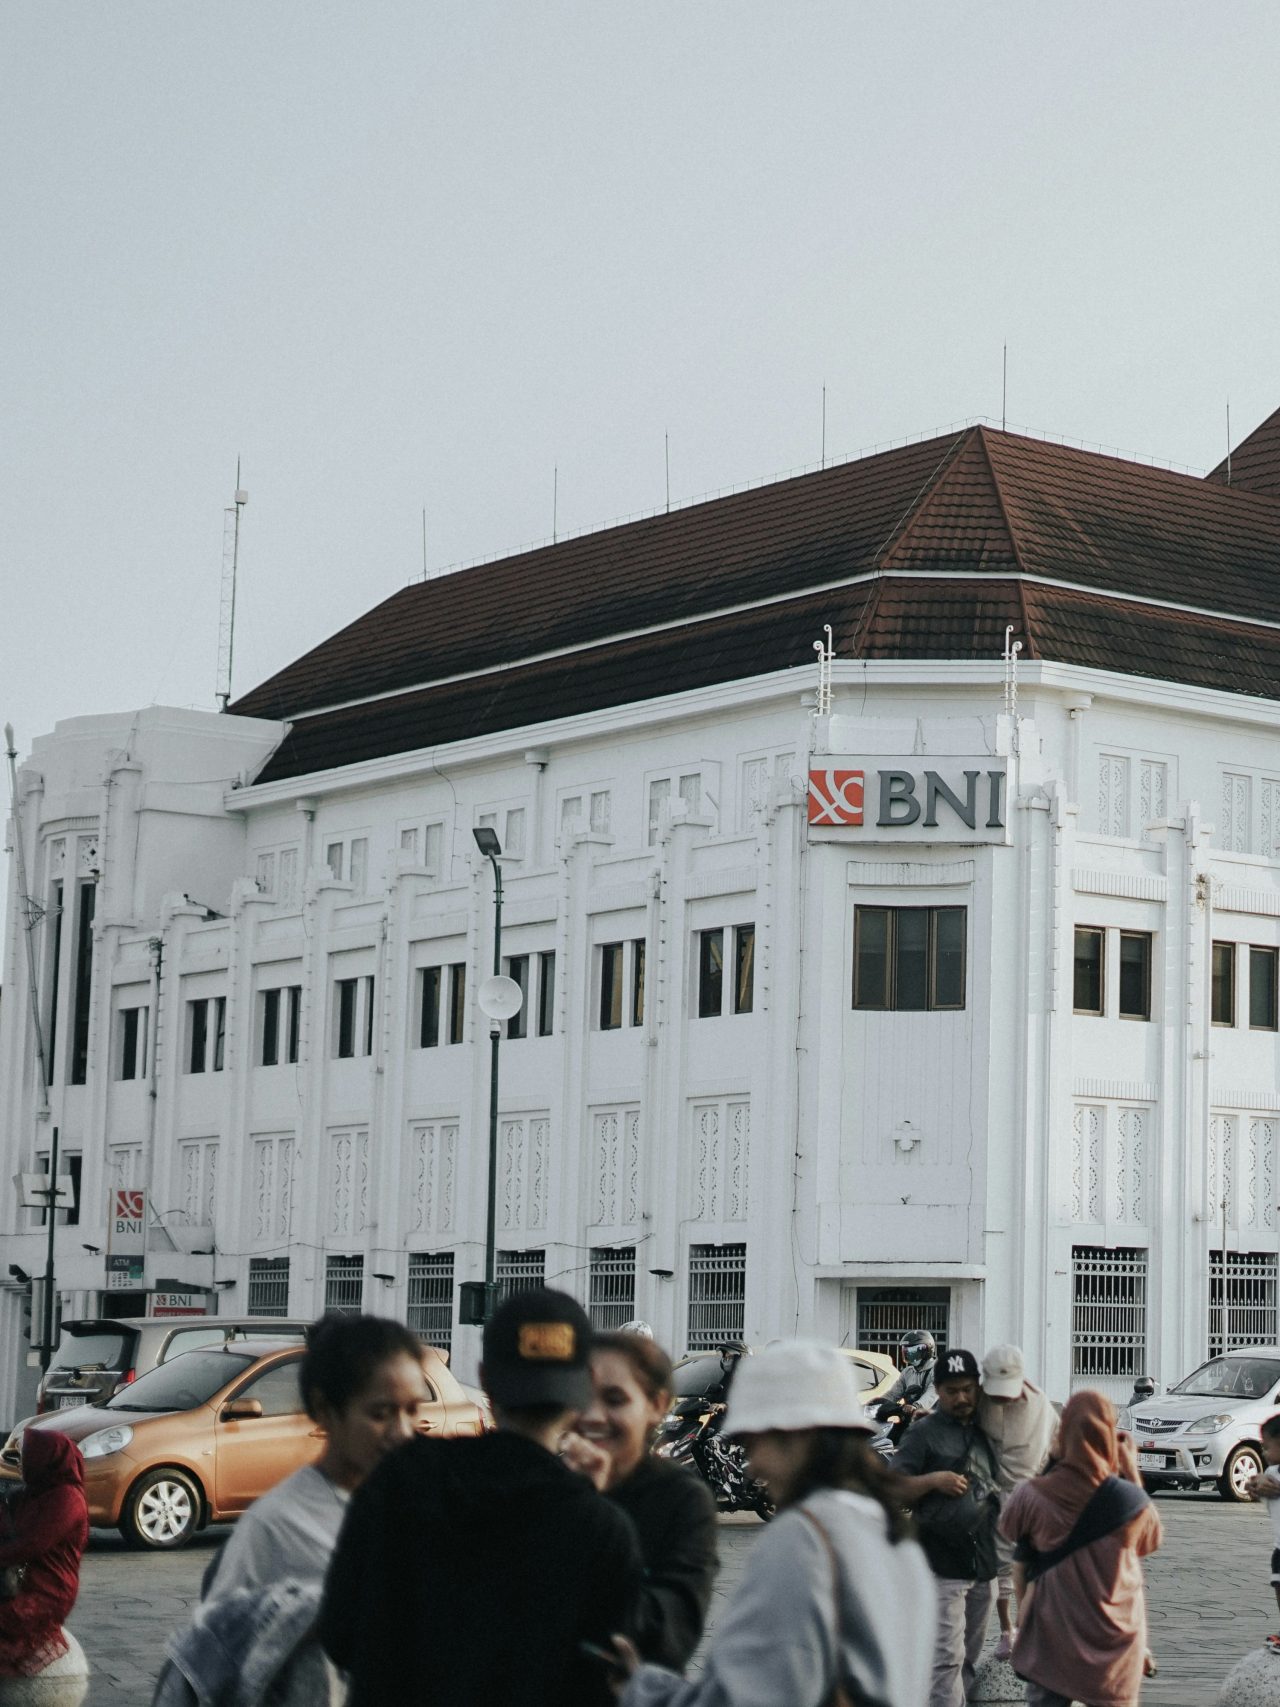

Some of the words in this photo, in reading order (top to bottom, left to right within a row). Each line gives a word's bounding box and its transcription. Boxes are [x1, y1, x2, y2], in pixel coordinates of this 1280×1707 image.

[876, 770, 1006, 830] BNI
[116, 1221, 142, 1234] BNI
[113, 1258, 130, 1267] ATM
[169, 1295, 192, 1307] BNI
[947, 1355, 966, 1373] NY
